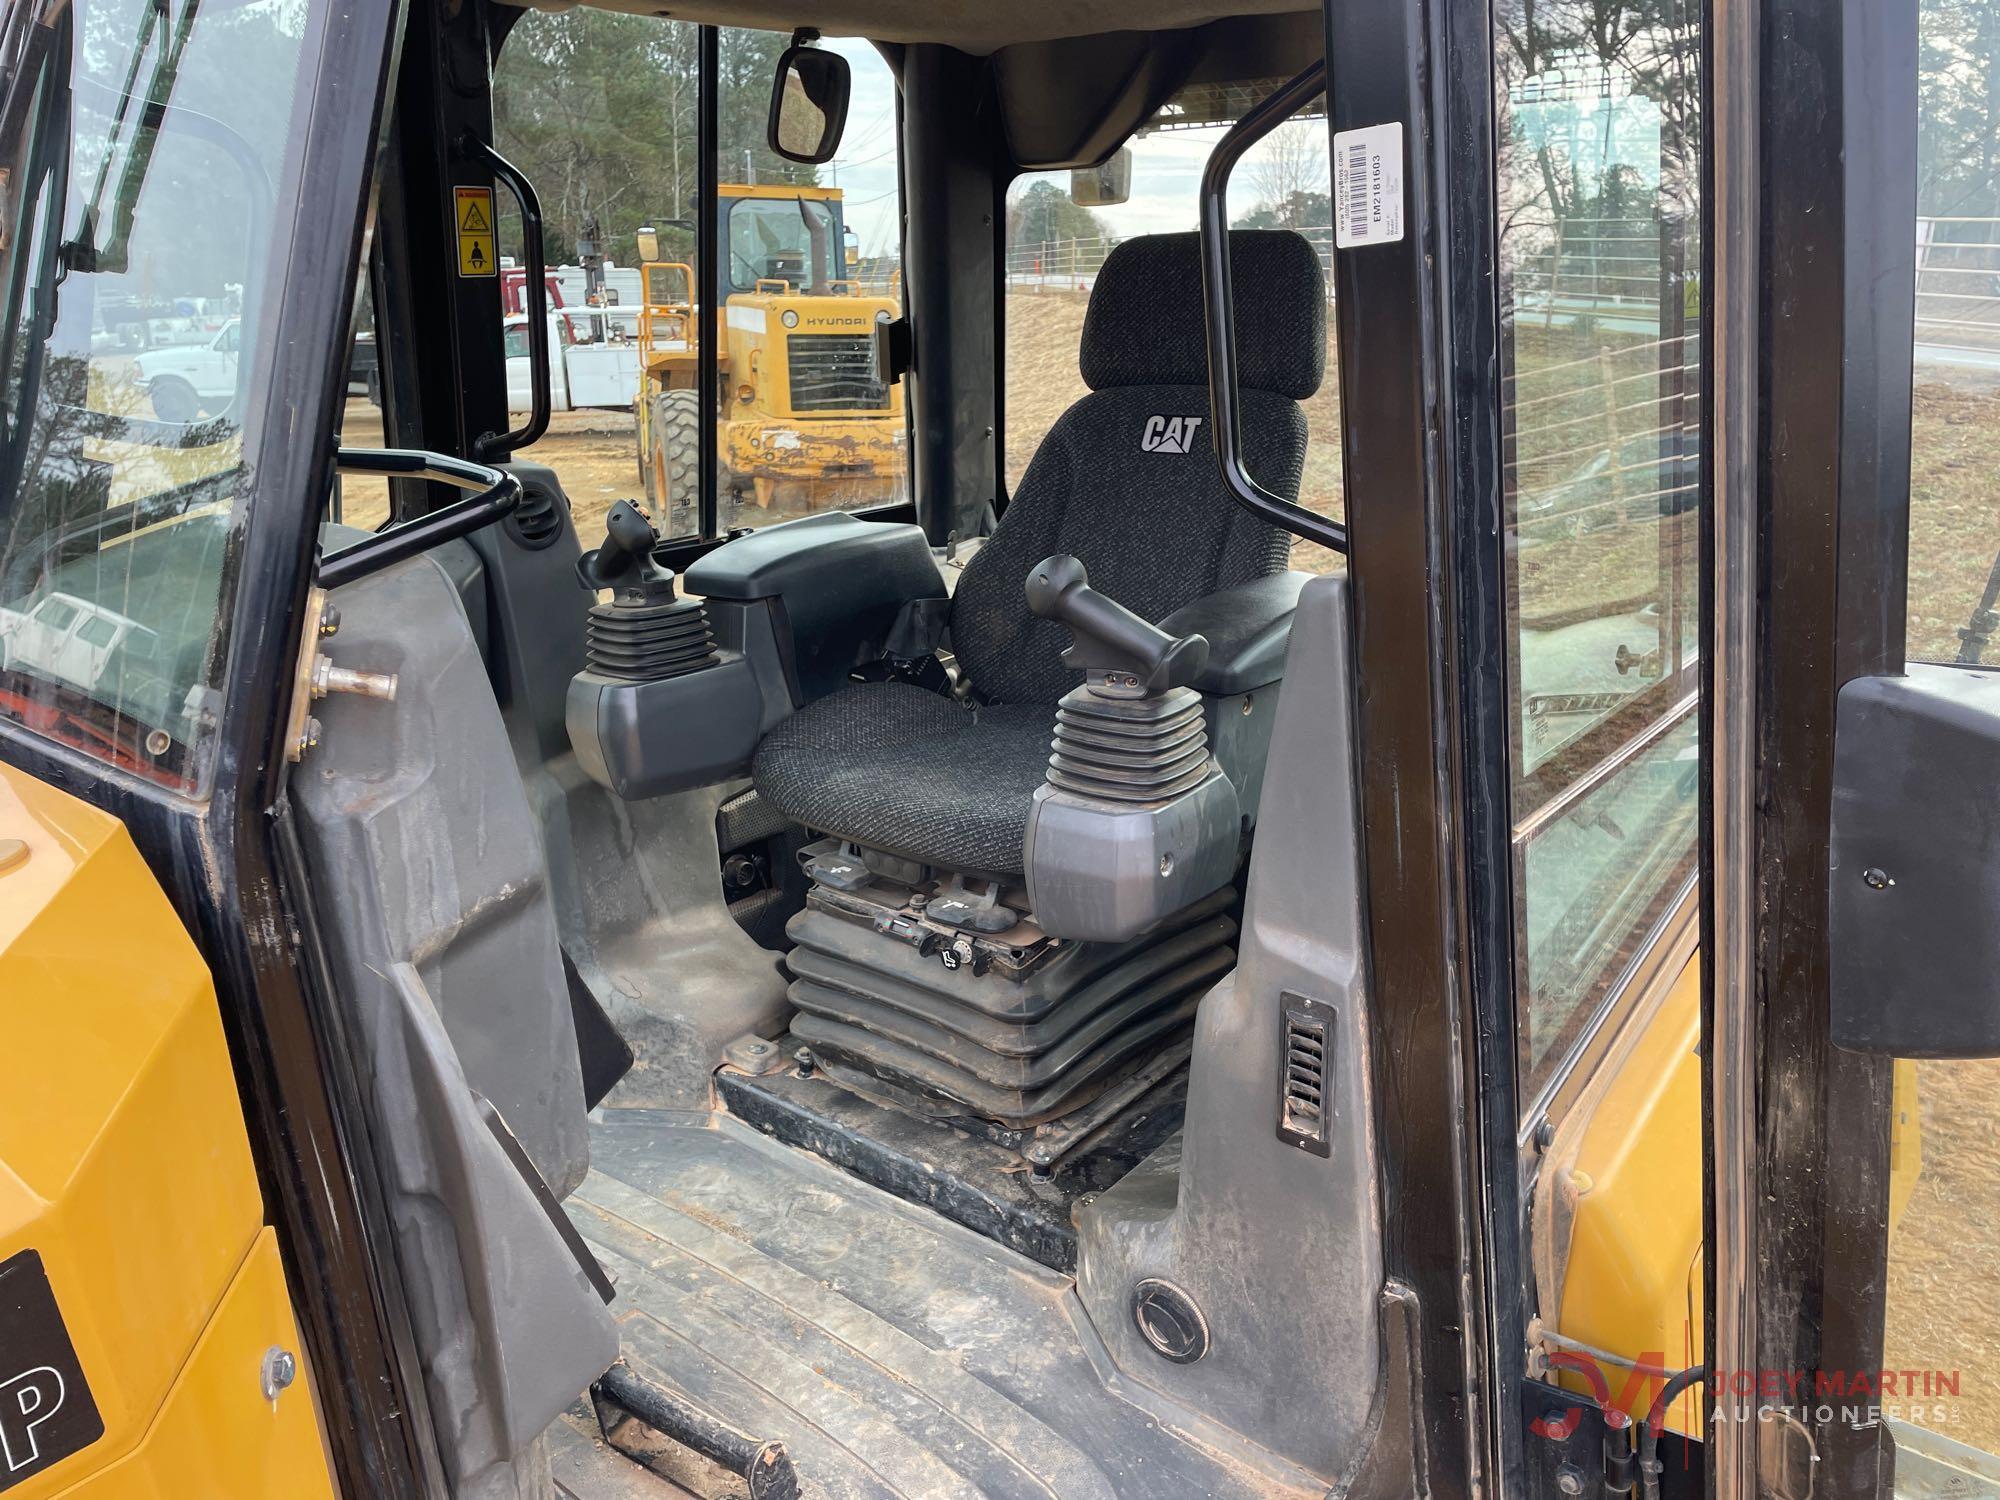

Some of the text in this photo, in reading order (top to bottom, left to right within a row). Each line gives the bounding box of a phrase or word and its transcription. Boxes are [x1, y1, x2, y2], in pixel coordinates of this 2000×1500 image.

[1372, 154, 1382, 223] EM2181603
[807, 318, 866, 326] HYUNDAI
[1141, 415, 1203, 454] CAT
